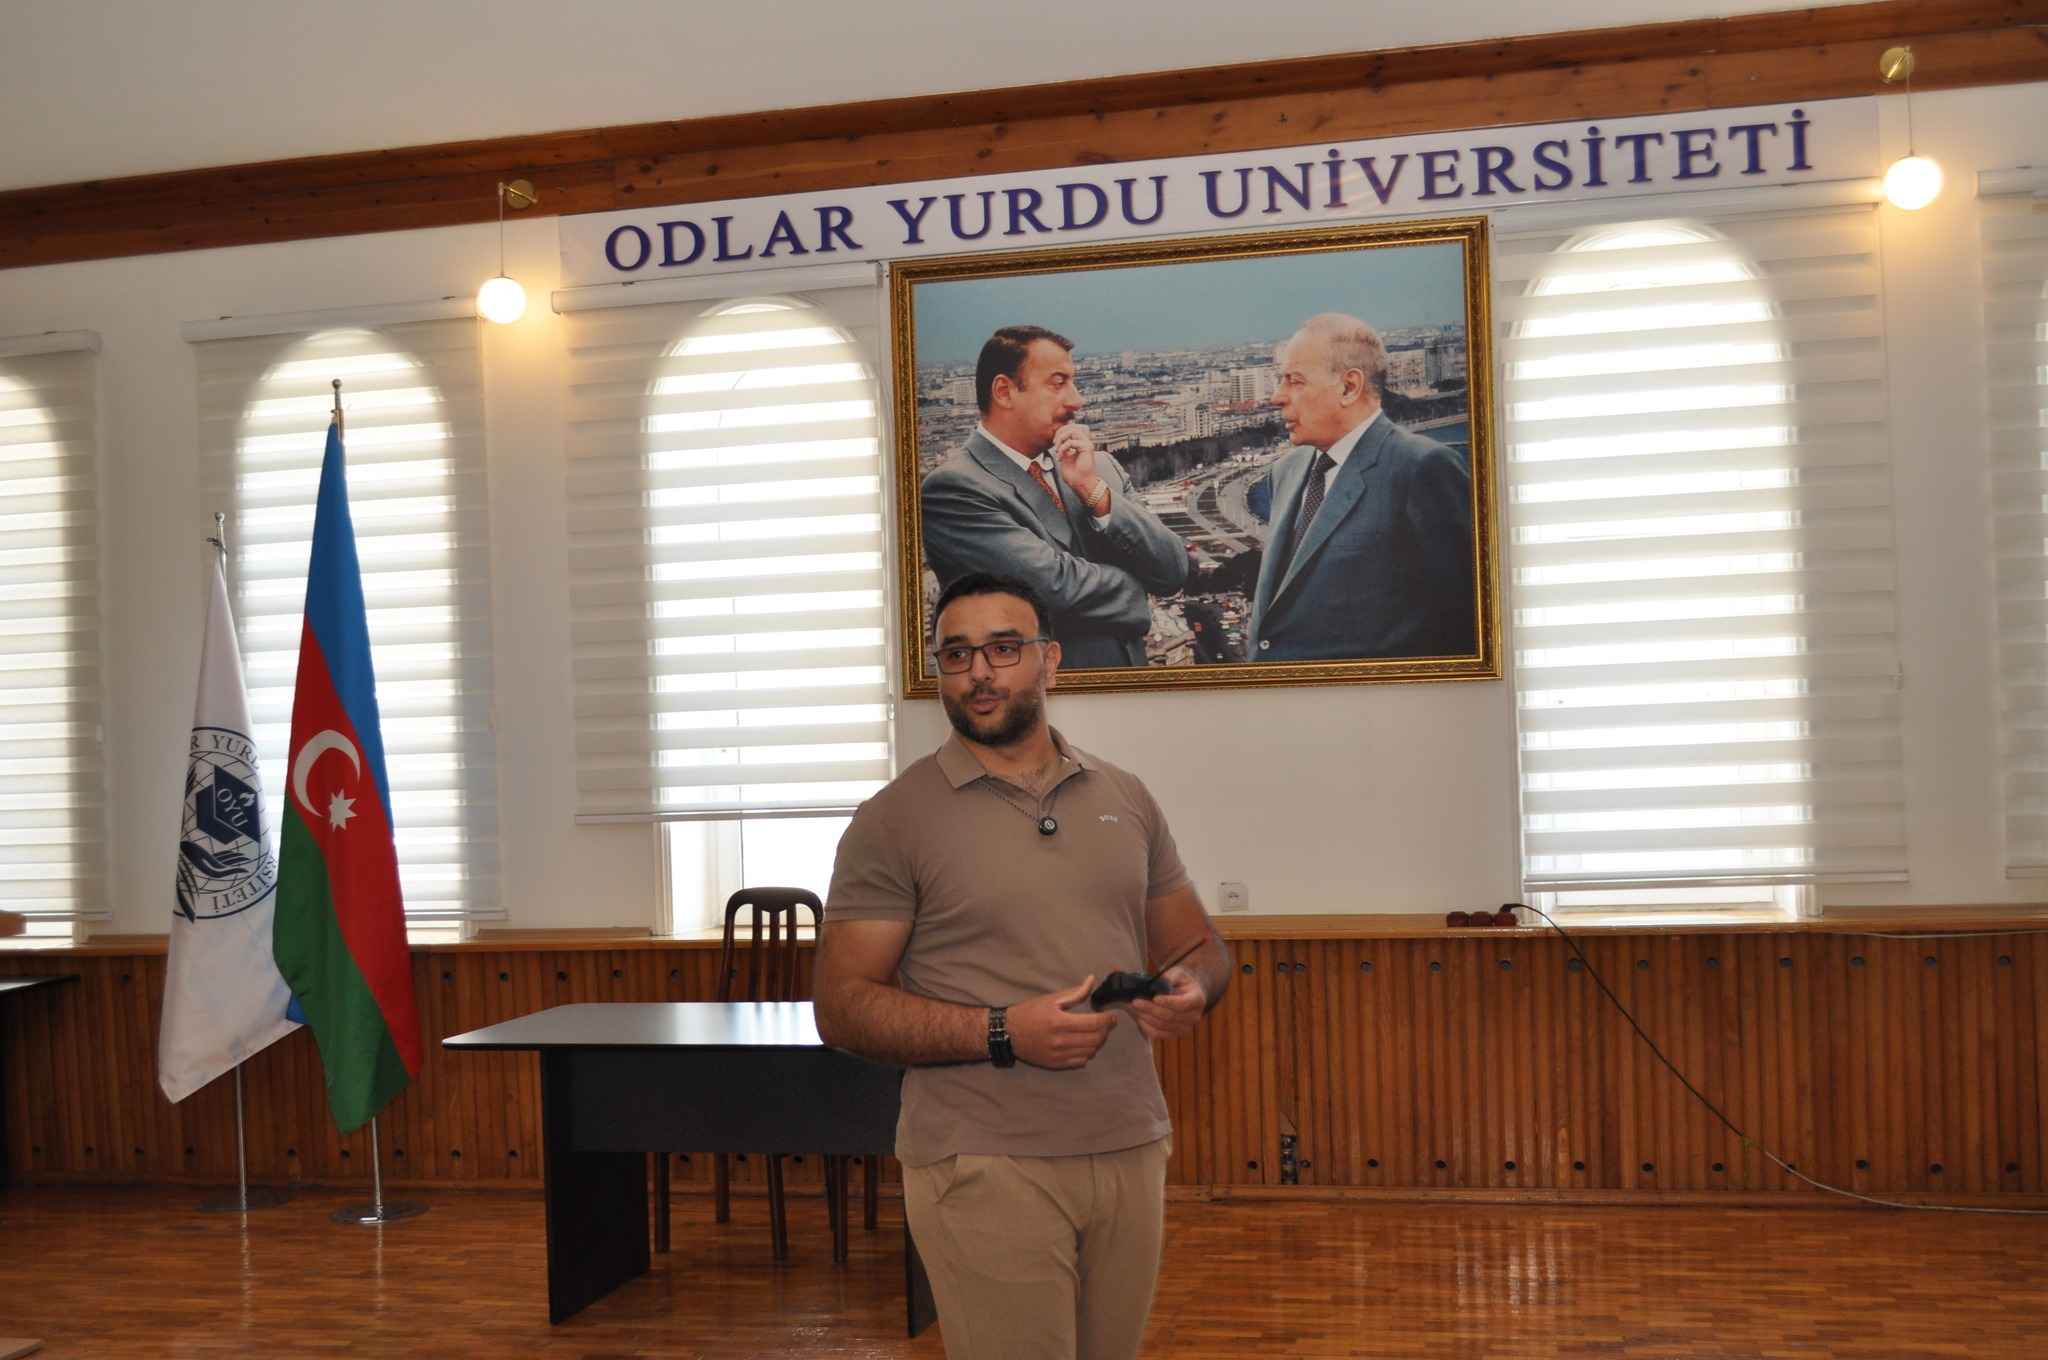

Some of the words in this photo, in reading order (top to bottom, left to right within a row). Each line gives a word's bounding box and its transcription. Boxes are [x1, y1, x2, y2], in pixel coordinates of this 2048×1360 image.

[605, 206, 862, 272] ODLAR
[888, 176, 1168, 246] YURDU
[1199, 109, 1812, 218] UNİVERSİTETİ
[216, 788, 248, 827] OYU
